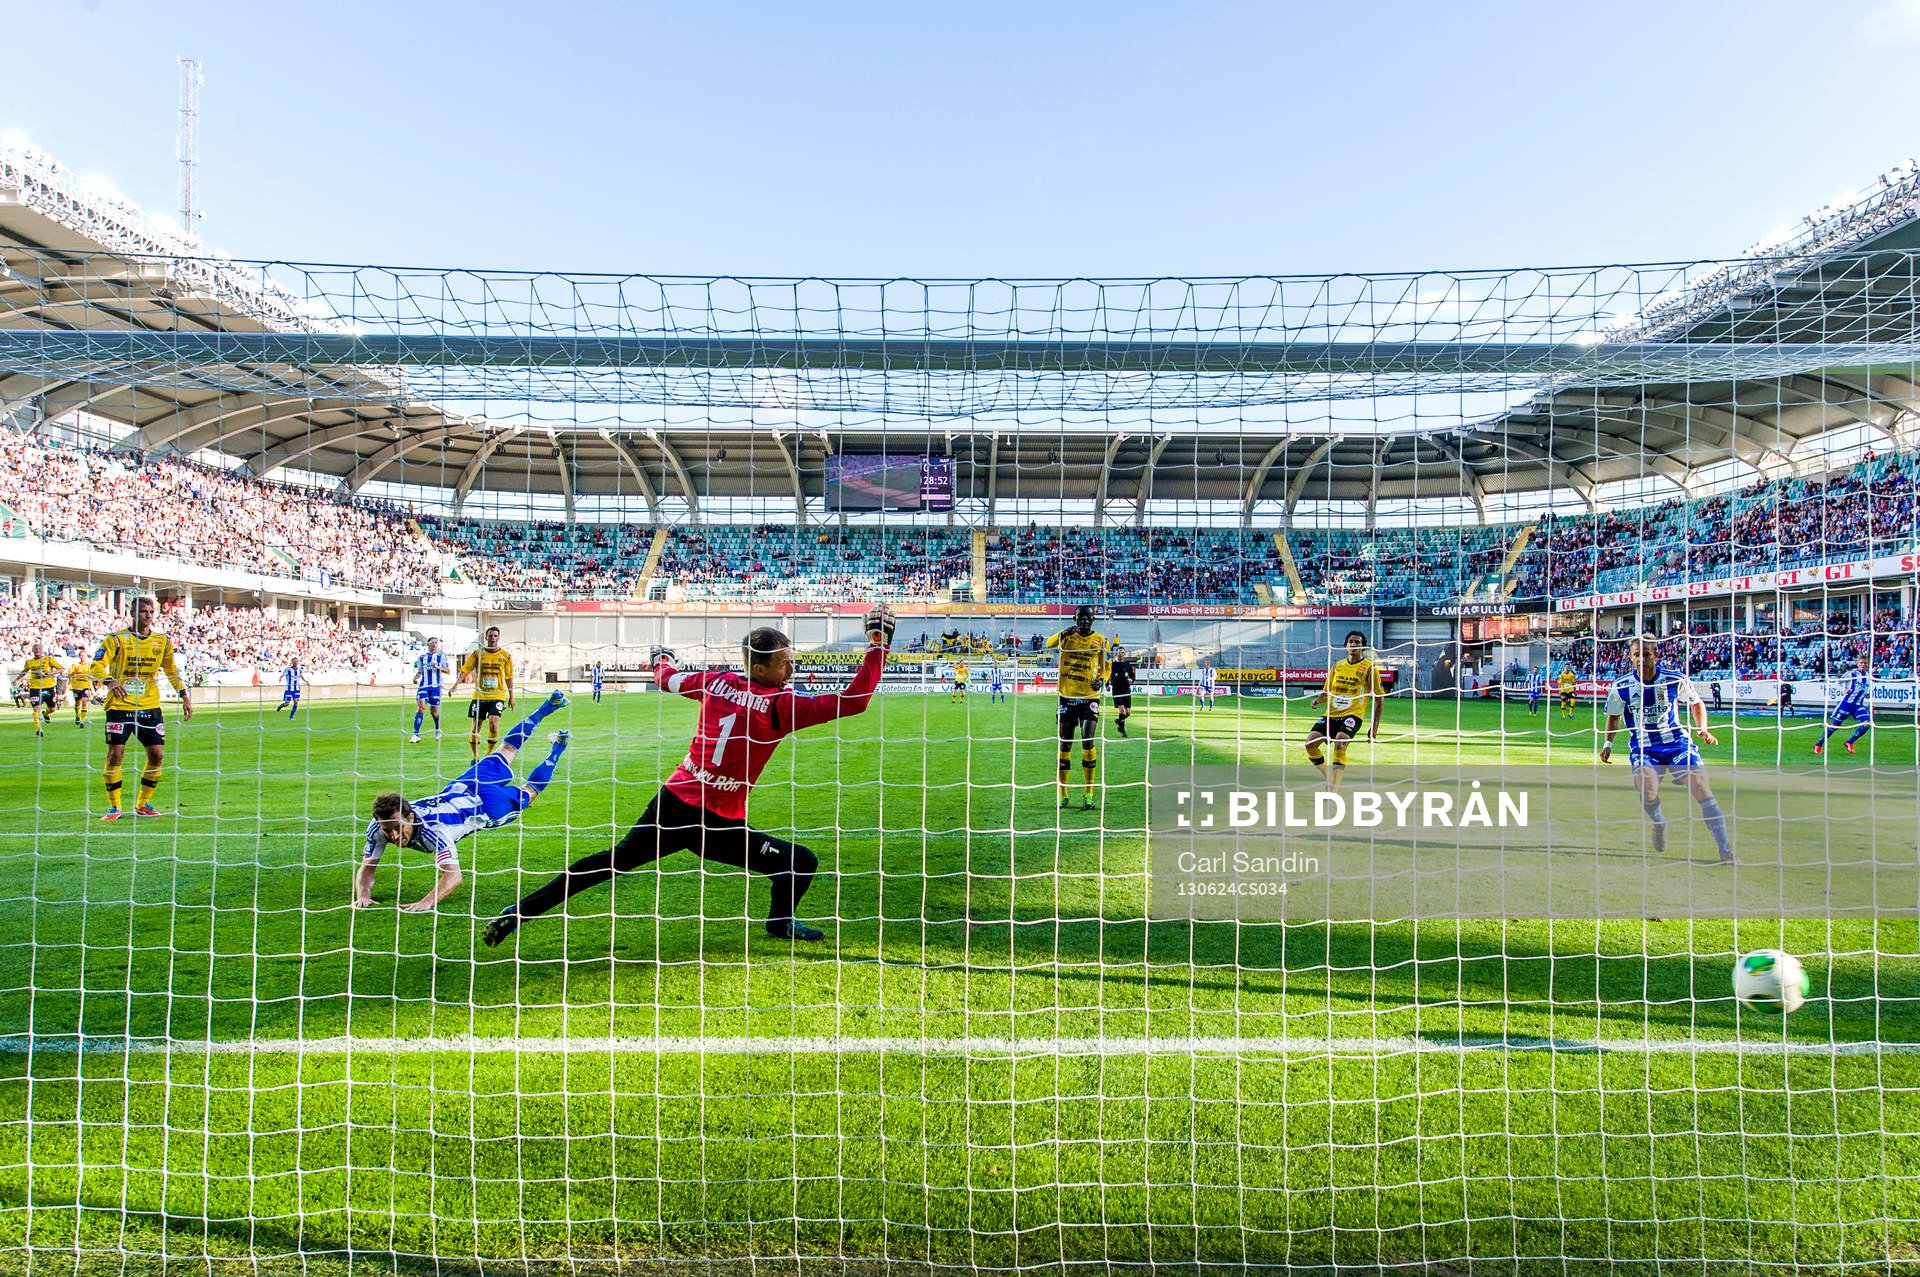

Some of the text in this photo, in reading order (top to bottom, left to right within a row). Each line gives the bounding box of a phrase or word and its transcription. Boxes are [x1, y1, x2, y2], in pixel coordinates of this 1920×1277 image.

[923, 476, 948, 485] 28:52
[1825, 563, 1855, 580] GT
[1729, 576, 1753, 591] GT
[1774, 570, 1801, 586] GT
[1652, 587, 1671, 600] GT
[1689, 582, 1711, 596] GT
[1589, 595, 1606, 607] GT
[1619, 592, 1636, 604] GT
[985, 605, 1047, 613] UNSTOPPABLE
[1149, 606, 1170, 614] UEFA
[1172, 606, 1202, 614] Dam-EM
[1204, 606, 1225, 614] 2013
[1302, 607, 1325, 615] Ullevi
[1432, 604, 1516, 615] GAMLA ULLEVI
[1561, 599, 1577, 610] GT
[1147, 670, 1191, 679] exceed
[1220, 673, 1273, 681] MARKBYGG
[711, 712, 737, 767] 1
